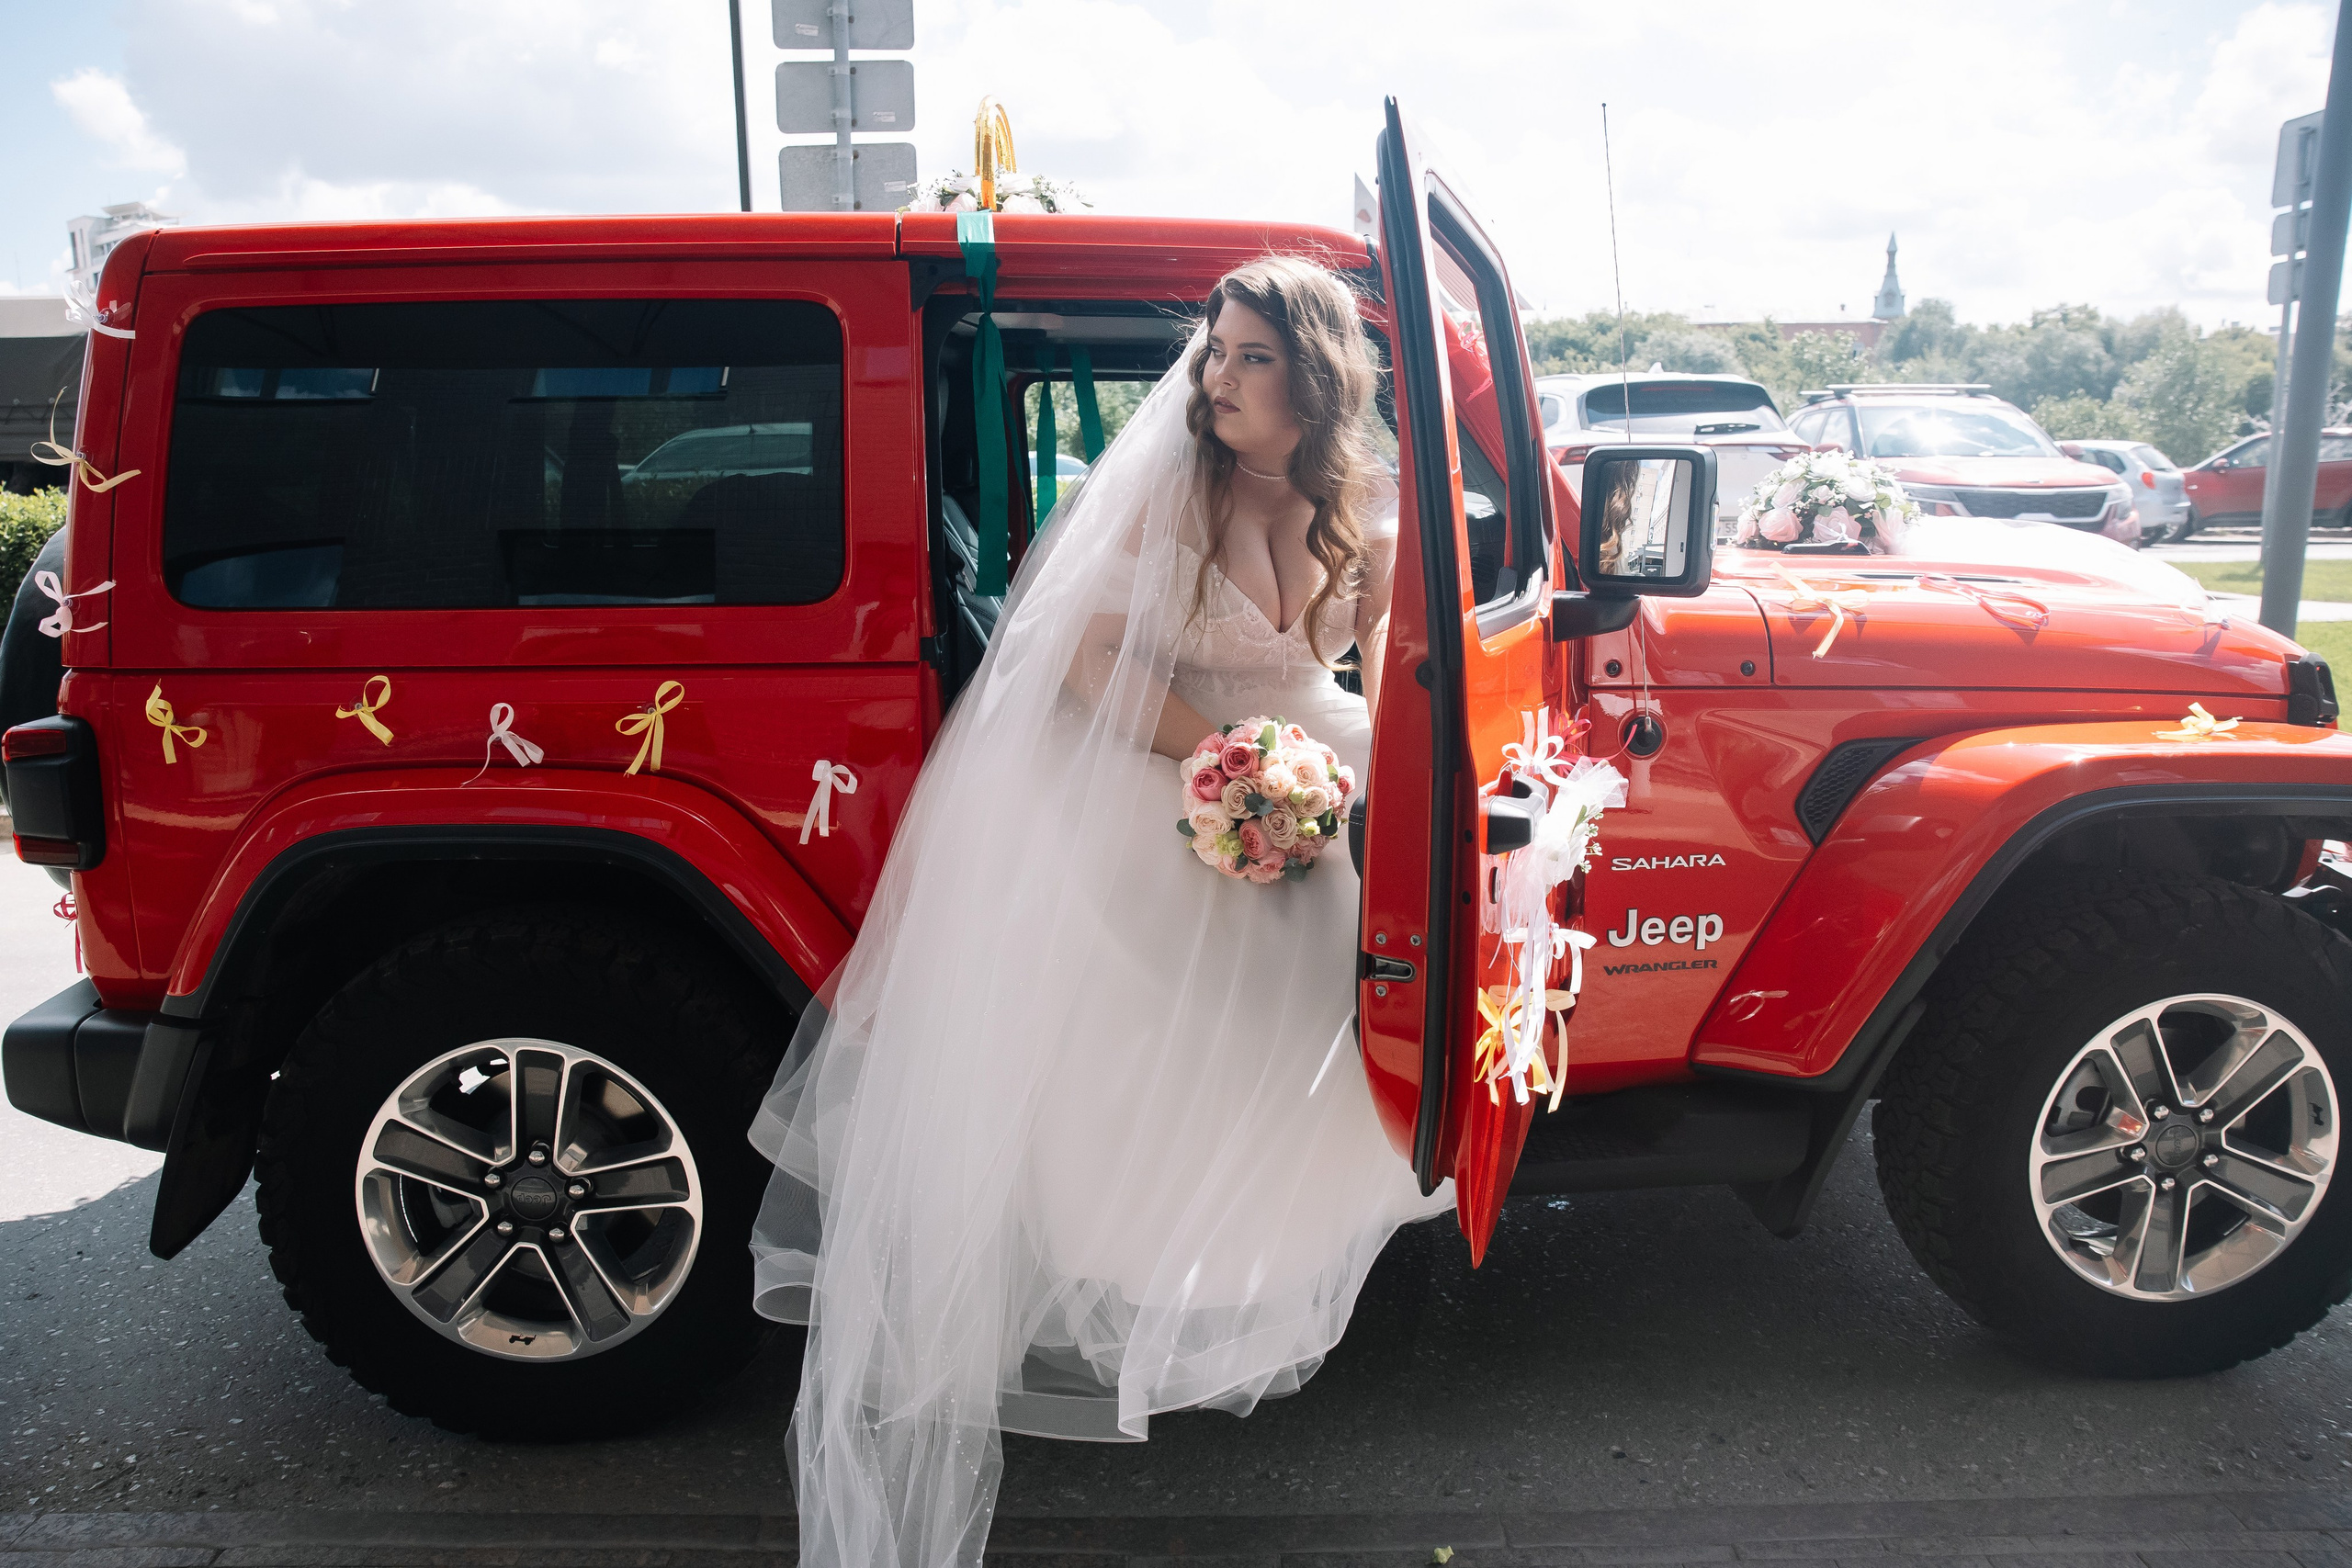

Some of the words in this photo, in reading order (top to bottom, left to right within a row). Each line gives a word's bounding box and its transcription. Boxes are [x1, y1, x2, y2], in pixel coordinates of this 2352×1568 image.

[1611, 853, 1726, 871] SAHARA
[1607, 908, 1724, 951] Jeep
[1603, 959, 1718, 976] WRANGLER
[516, 1193, 552, 1205] Jeep
